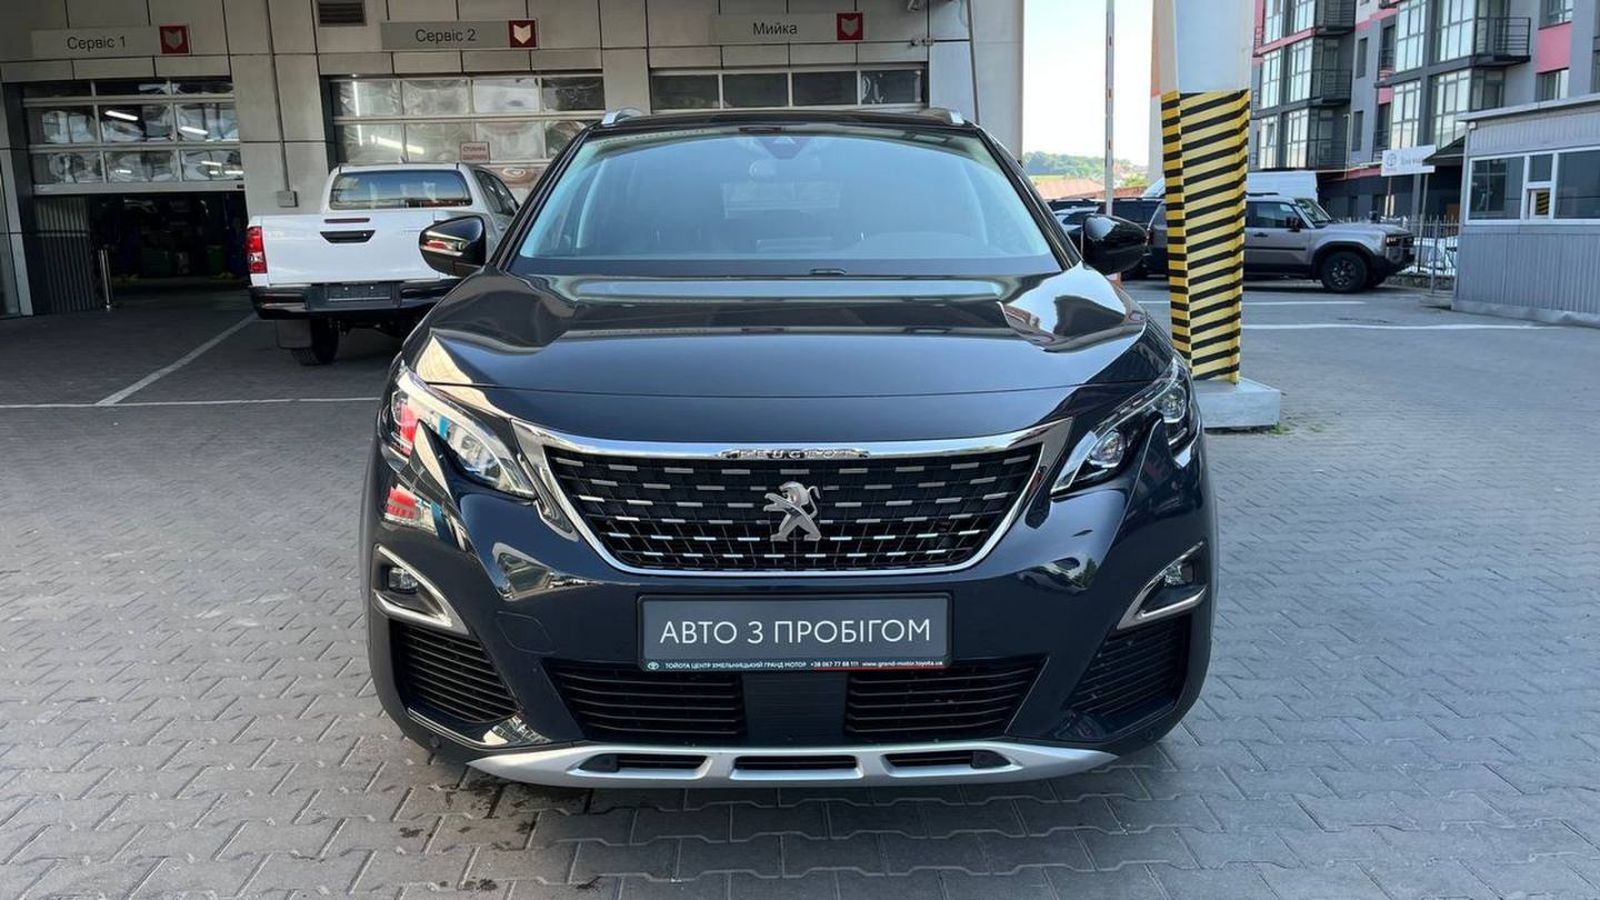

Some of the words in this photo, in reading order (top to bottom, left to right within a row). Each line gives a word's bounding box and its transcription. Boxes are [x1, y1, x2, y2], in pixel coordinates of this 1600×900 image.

[416, 29, 464, 44] Сервіс
[467, 28, 476, 41] 2
[753, 22, 797, 35] Мийка
[67, 36, 115, 52] Сервіс
[119, 35, 126, 47] 1
[660, 620, 738, 645] АВТО
[747, 620, 764, 644] З
[774, 618, 931, 644] ПРОБІГОМ
